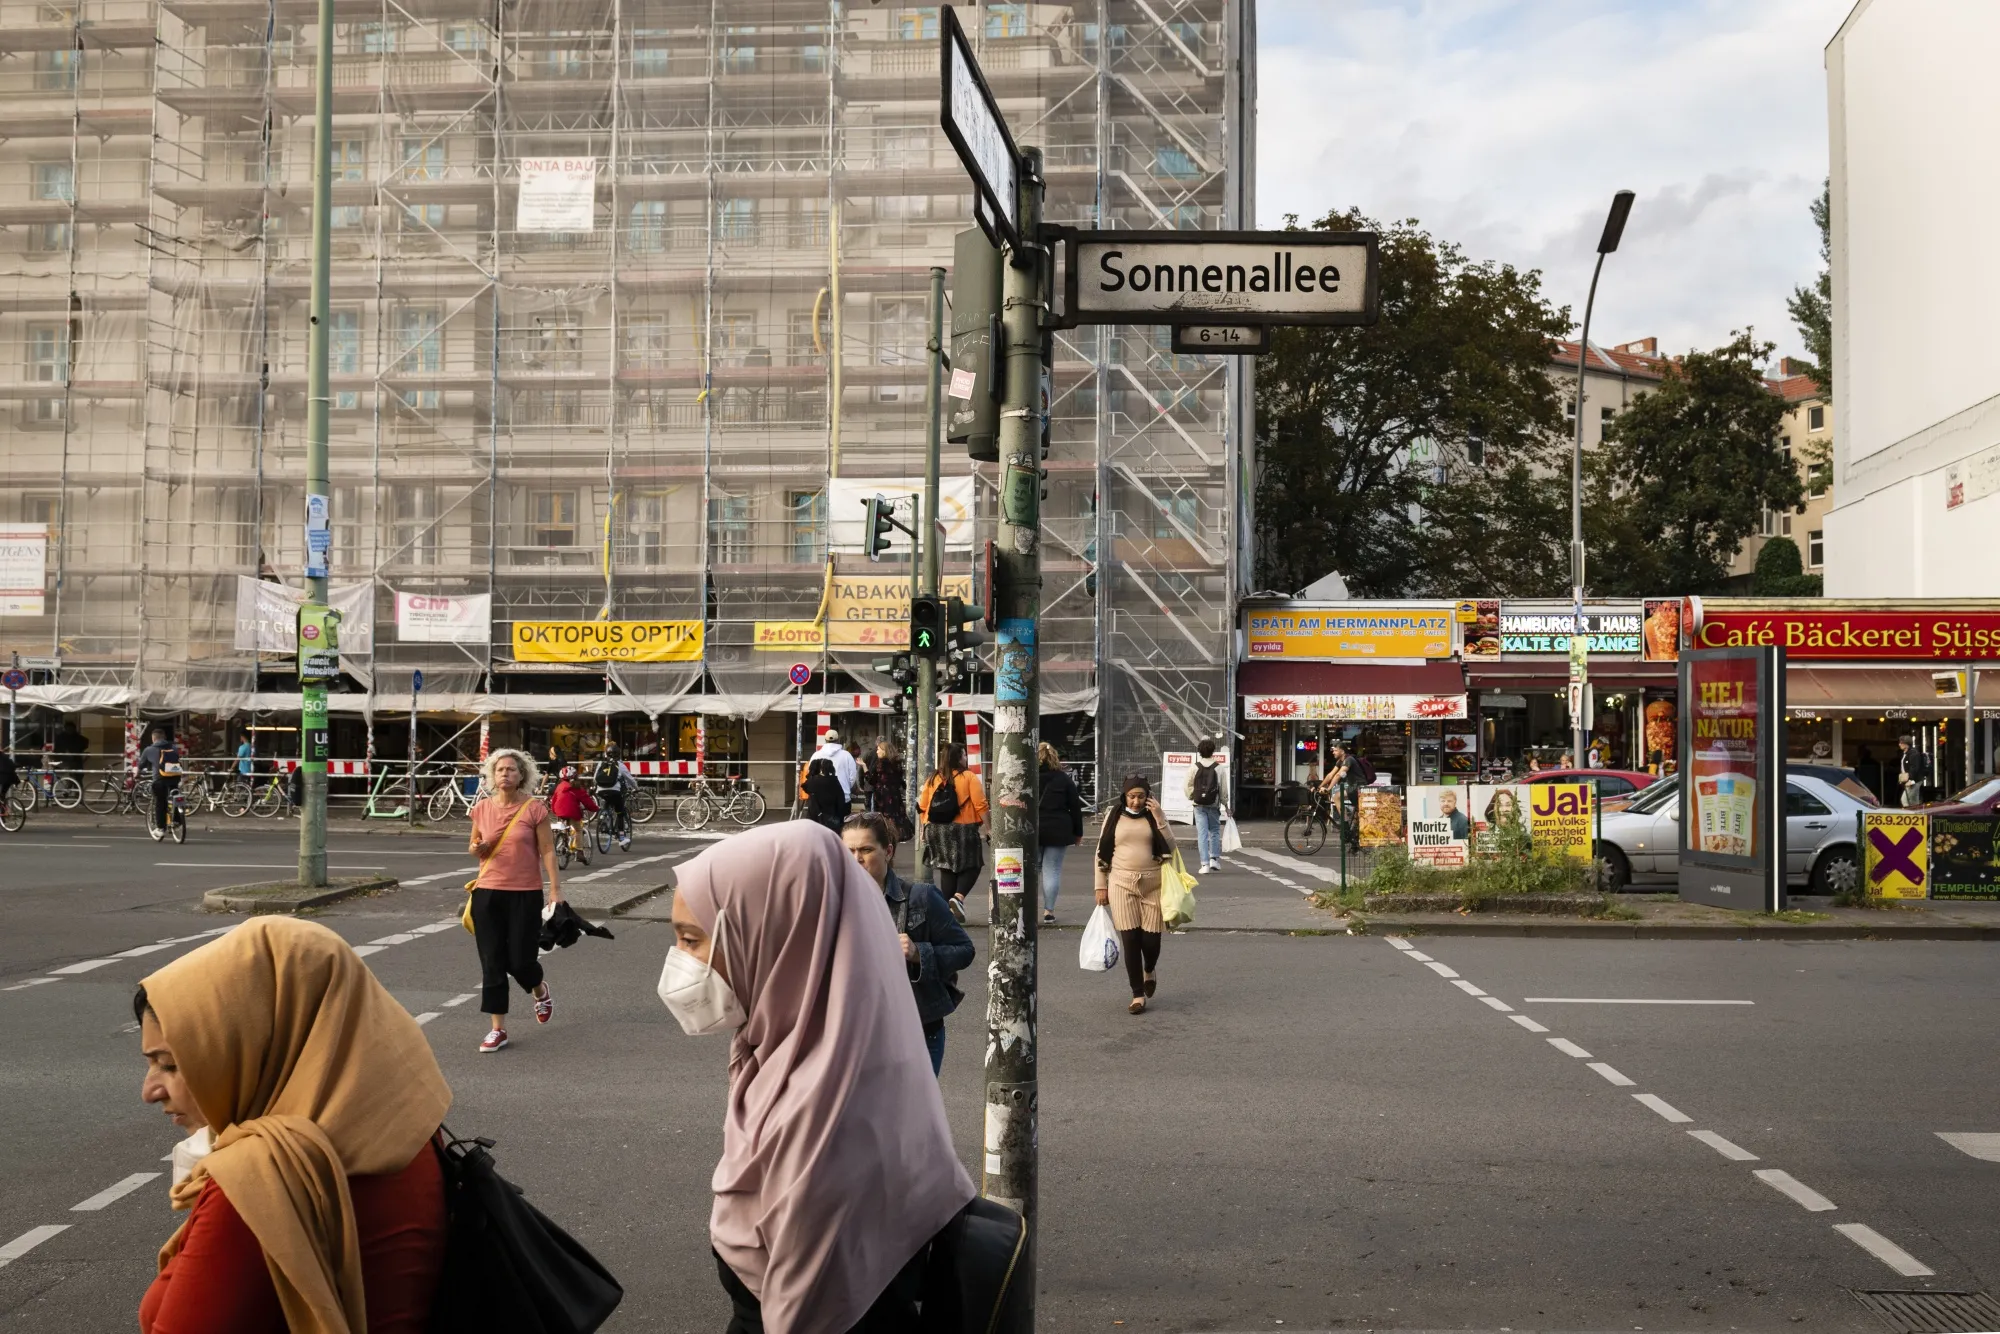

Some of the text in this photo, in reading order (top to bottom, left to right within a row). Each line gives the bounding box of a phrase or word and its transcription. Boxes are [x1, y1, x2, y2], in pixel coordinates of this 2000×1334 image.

[564, 161, 594, 171] BAU
[1100, 251, 1341, 292] Sonnenallee
[1200, 329, 1240, 342] 6-14
[832, 585, 969, 599] TABAKWEN
[408, 596, 449, 610] GM
[1251, 616, 1447, 629] SPÄTI AM HERMANNPLATZ
[1503, 616, 1638, 633] HAMBURGR HAUS
[519, 625, 696, 643] OKTOPUS OPTIK
[778, 629, 821, 642] LOTTO
[1700, 620, 1774, 647] Café
[1784, 621, 1922, 647] Bäckerei
[1503, 635, 1638, 651] KALTE GRÄNKE
[579, 647, 637, 658] MOSCOT
[1261, 703, 1284, 711] 0,80
[1422, 703, 1445, 711] 0,80
[1795, 709, 1816, 718] Süss
[1885, 709, 1908, 719] Café
[1697, 718, 1755, 738] NATUR
[1532, 785, 1588, 816] Ja!
[1413, 821, 1447, 832] Moritz
[1533, 817, 1589, 827] zum Volks-
[1867, 815, 1925, 826] 26.9.2021
[1933, 818, 1992, 833] Theater
[1533, 827, 1586, 836] entscheid
[1413, 834, 1450, 845] Wittler
[1870, 887, 1883, 895] Ja!
